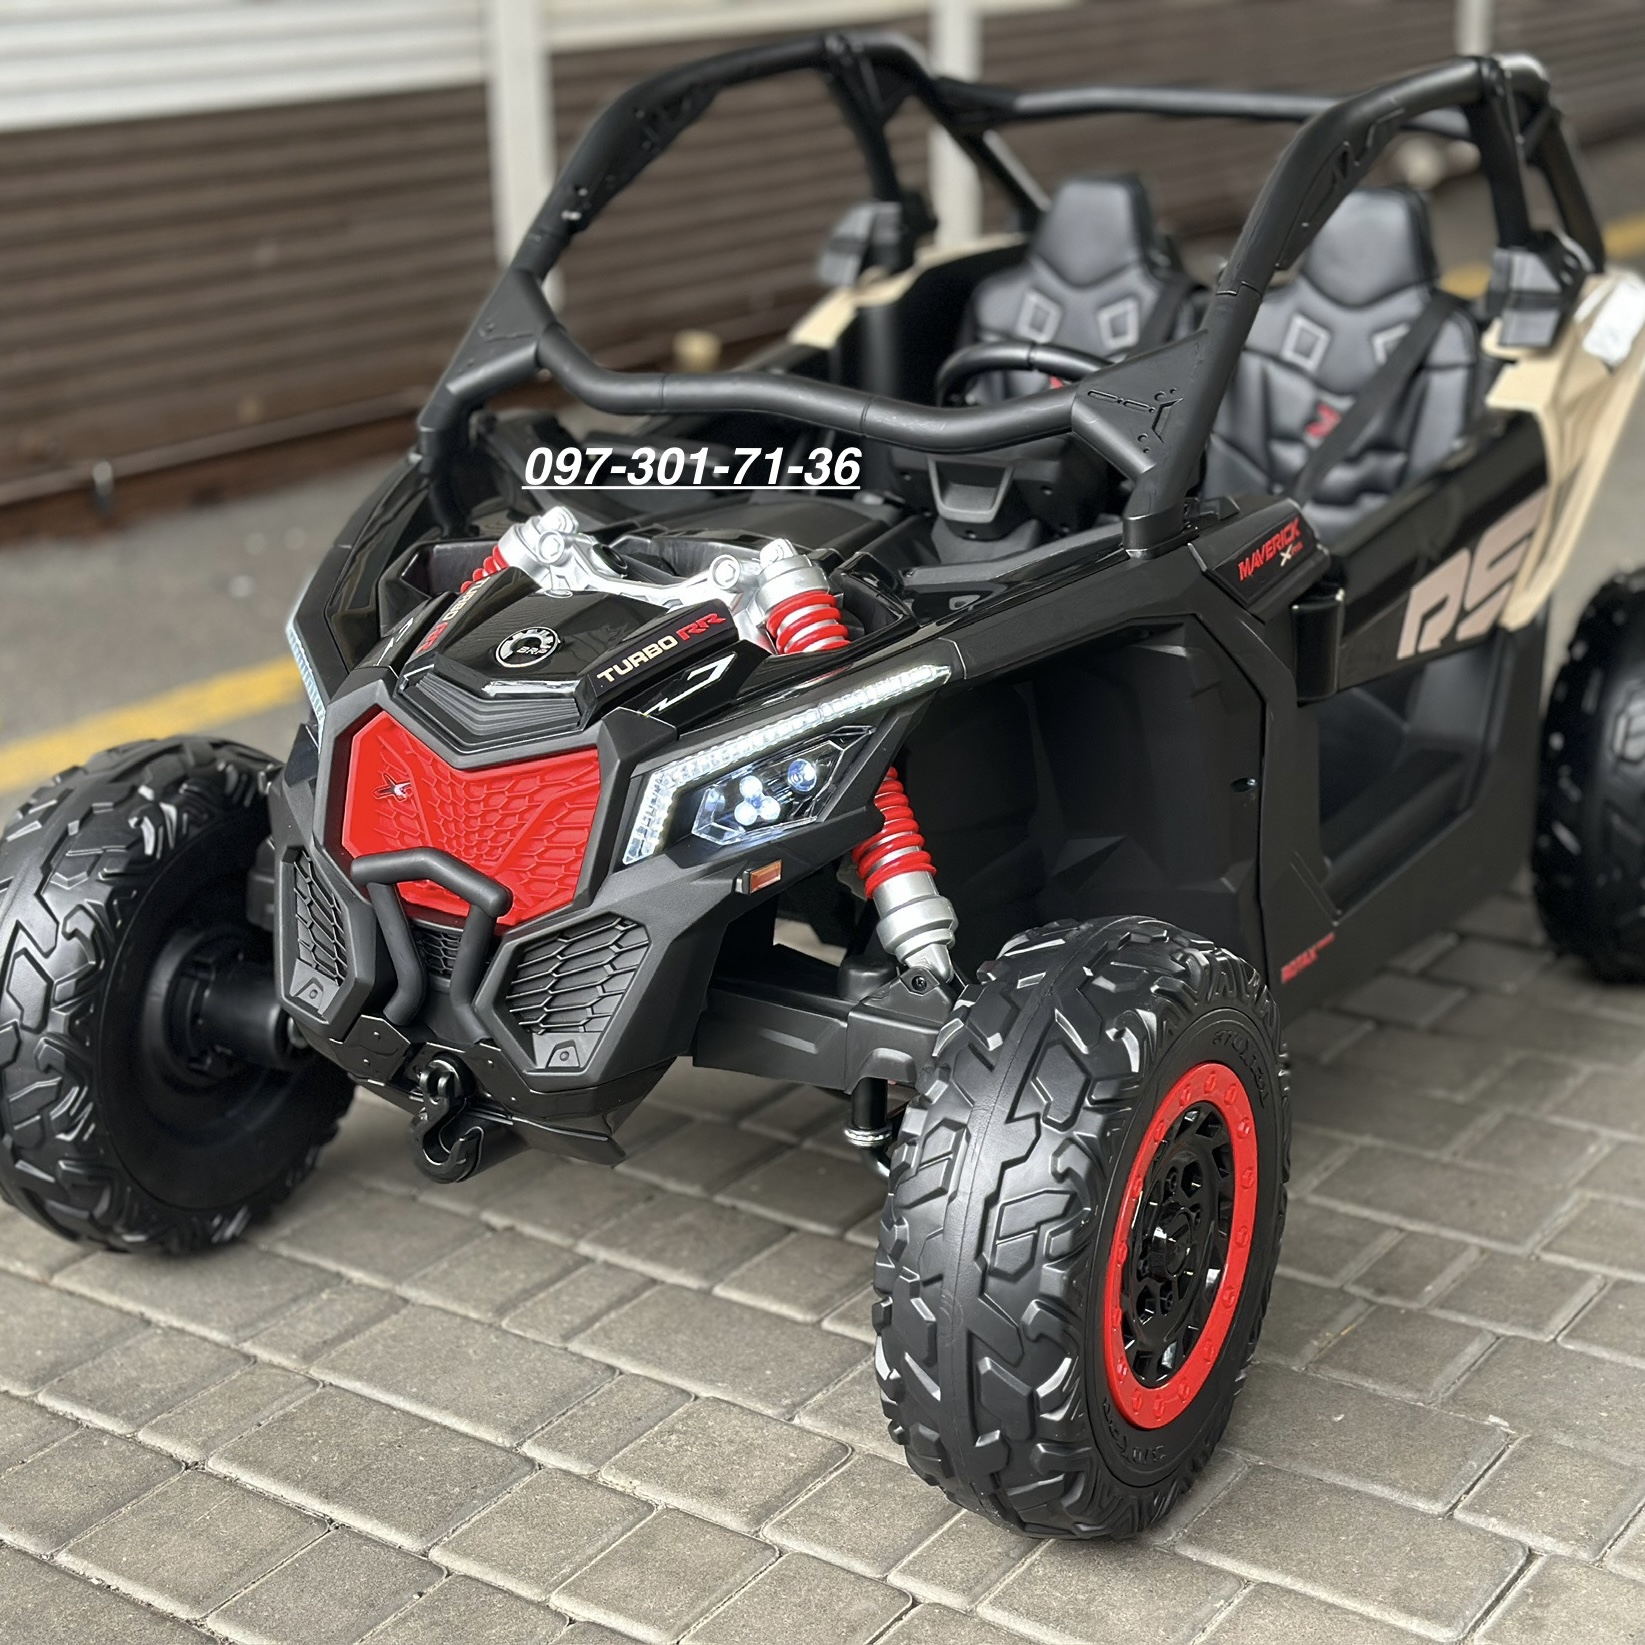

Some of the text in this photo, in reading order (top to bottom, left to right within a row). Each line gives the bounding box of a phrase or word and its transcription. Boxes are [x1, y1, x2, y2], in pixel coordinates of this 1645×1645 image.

[1237, 516, 1301, 581] MAVERICK
[516, 645, 549, 655] BRP
[596, 612, 727, 683] TURBO RR
